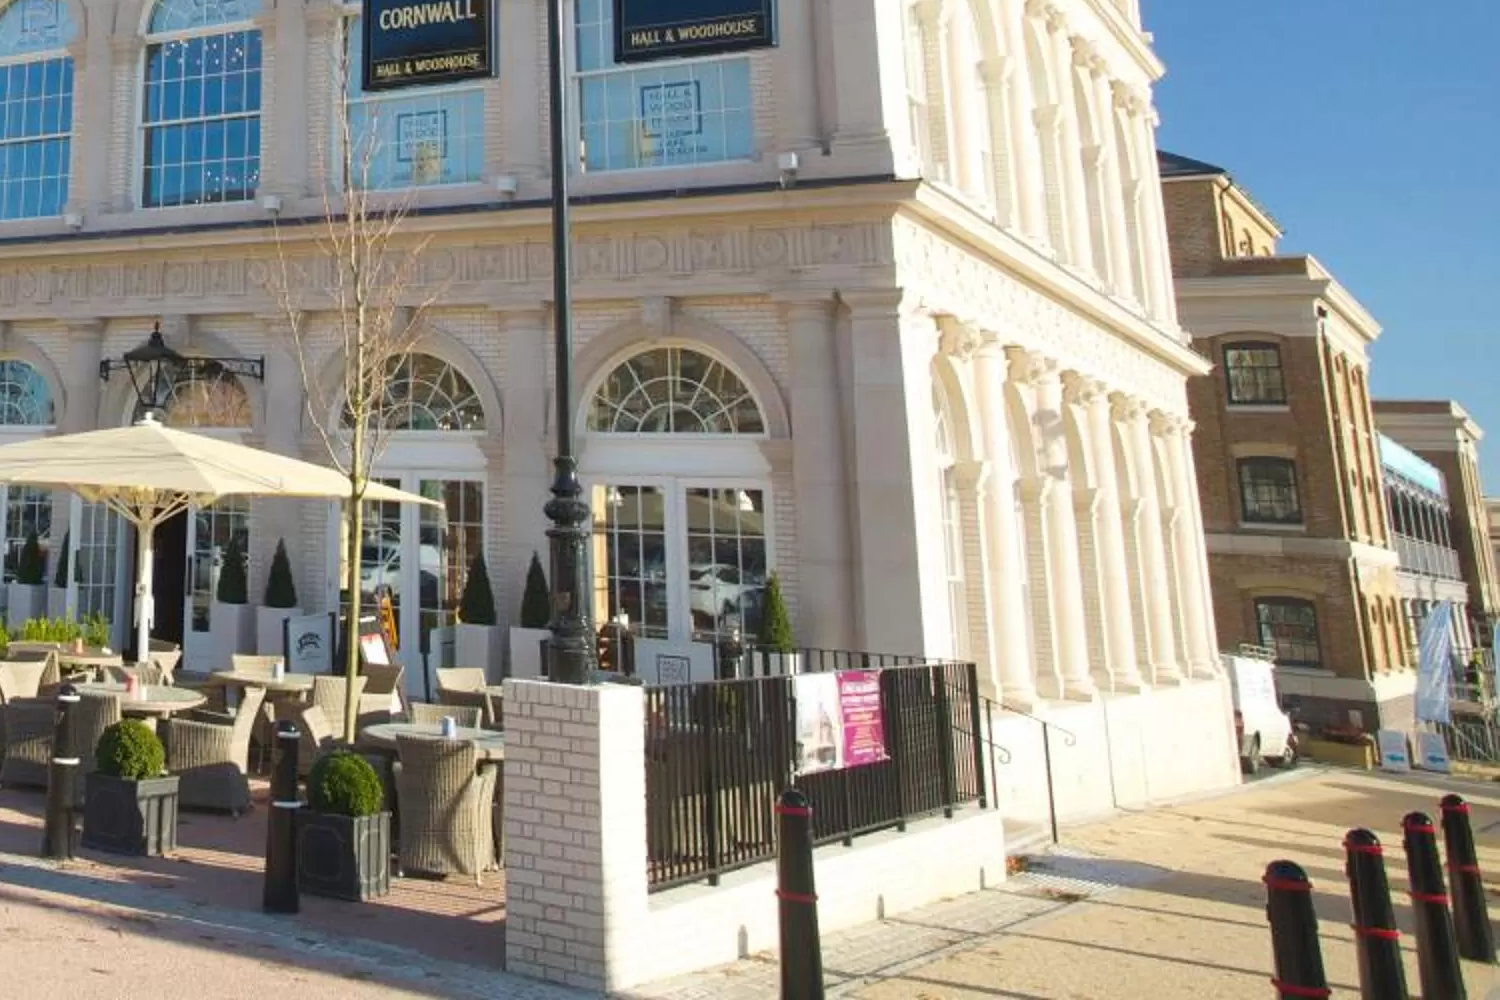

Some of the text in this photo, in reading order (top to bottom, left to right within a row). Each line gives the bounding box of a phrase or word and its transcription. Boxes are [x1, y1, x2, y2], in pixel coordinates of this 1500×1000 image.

[631, 19, 756, 47] HALL & WOODHOUSE
[376, 53, 479, 77] HALL & WOODHOUSE
